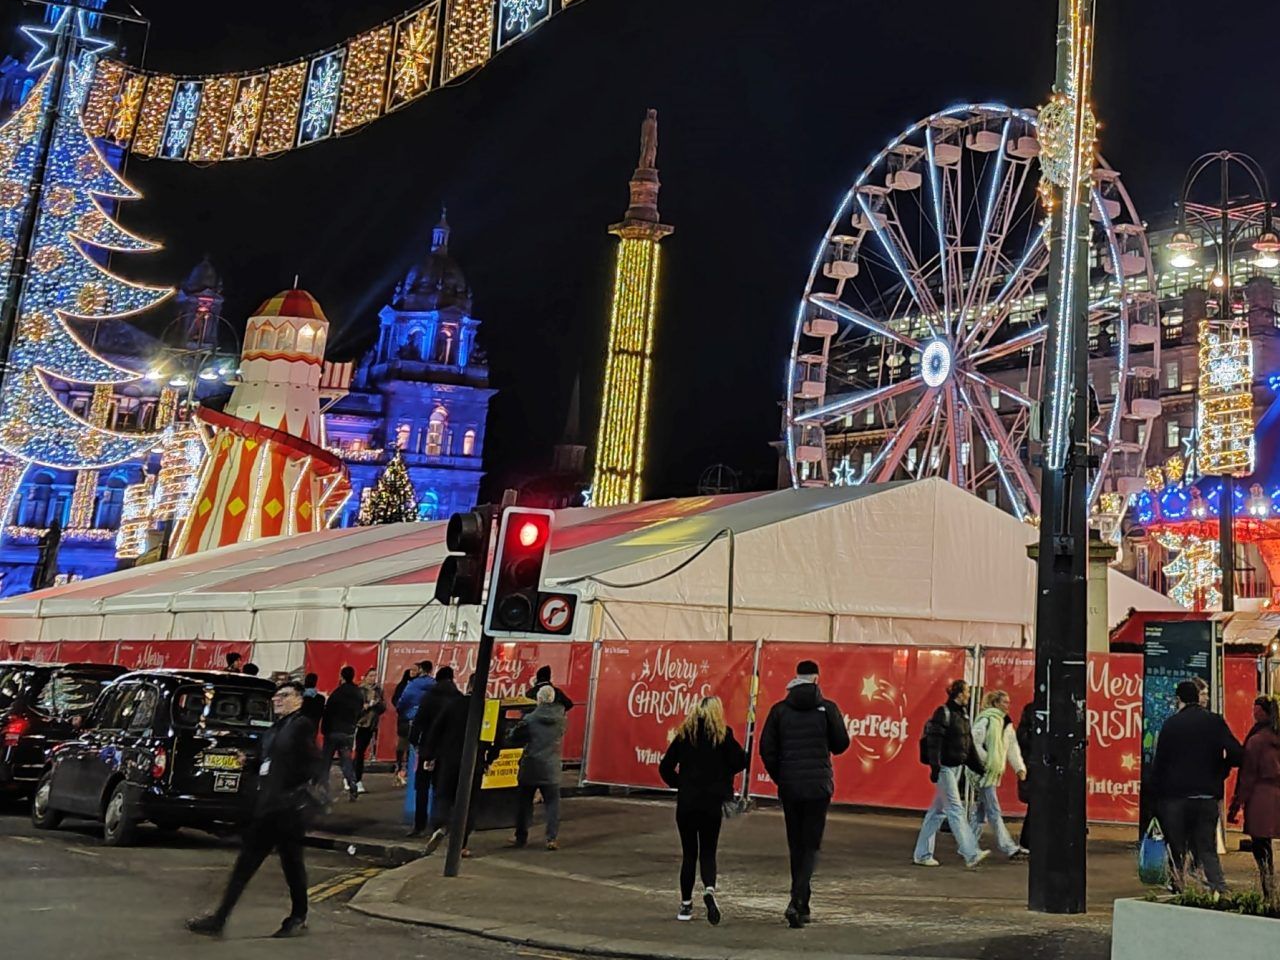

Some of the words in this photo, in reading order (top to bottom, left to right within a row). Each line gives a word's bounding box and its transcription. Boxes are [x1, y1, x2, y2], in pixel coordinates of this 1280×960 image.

[650, 648, 699, 688] Merry
[1087, 660, 1143, 699] Merr
[843, 713, 909, 742] terFest
